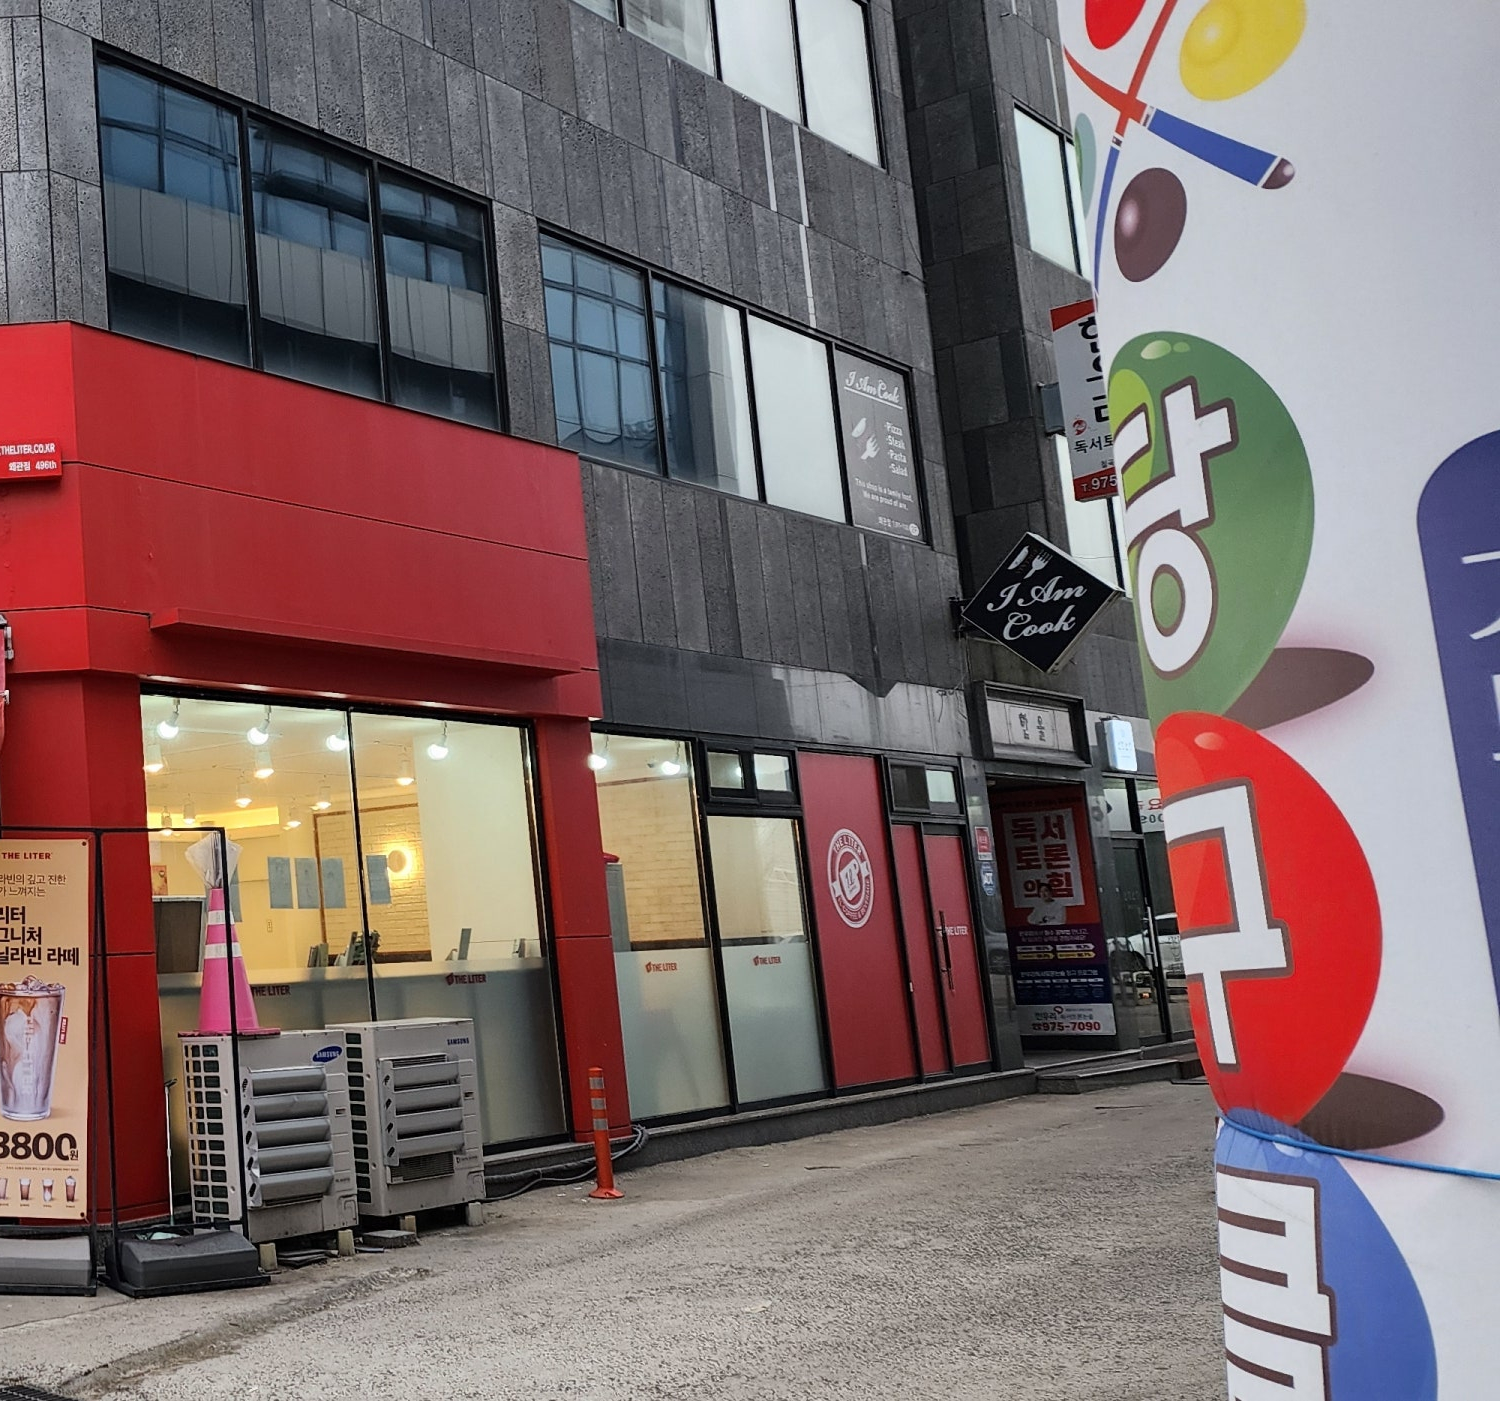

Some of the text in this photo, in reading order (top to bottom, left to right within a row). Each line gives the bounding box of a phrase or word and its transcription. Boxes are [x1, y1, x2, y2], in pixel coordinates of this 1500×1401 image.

[1017, 575, 1088, 607] Am
[1002, 604, 1077, 641] Cook
[1011, 814, 1067, 843] 독서
[1, 852, 51, 860] THE LITER
[1015, 843, 1071, 870] 토론
[27, 874, 46, 886] 깊고
[48, 874, 67, 886] 진한
[8, 886, 46, 898] 느껴지는
[46, 947, 80, 967] 라떼
[453, 972, 488, 985] THE LITER
[267, 984, 291, 996] LITER
[1041, 1020, 1102, 1032] 975-7090
[446, 1037, 470, 1046] SAMSUNG
[315, 1049, 341, 1061] SAMSUNG
